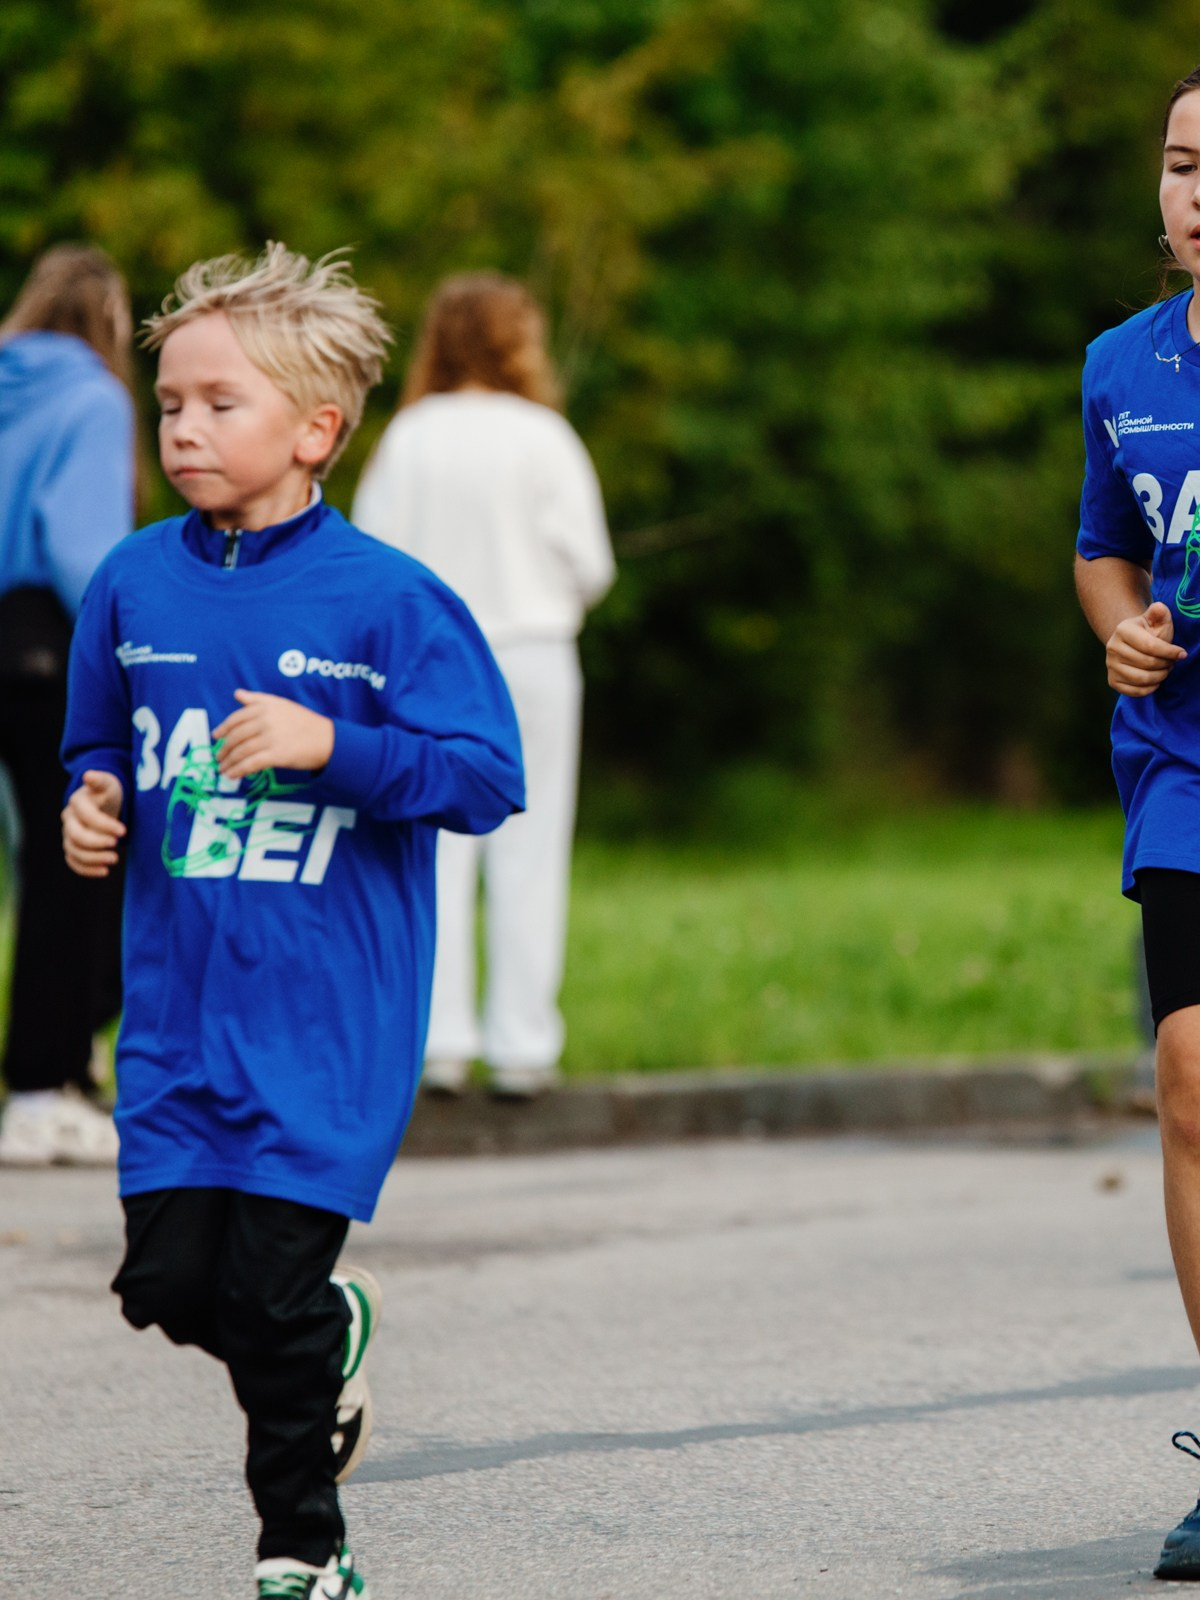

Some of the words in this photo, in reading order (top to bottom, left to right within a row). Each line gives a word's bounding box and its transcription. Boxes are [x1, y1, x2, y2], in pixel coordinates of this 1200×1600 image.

[1118, 415, 1152, 428] АОМНОЙ
[1118, 422, 1194, 436] ПОМЫШЛЕННОСТИ
[182, 797, 356, 885] БЕГ
